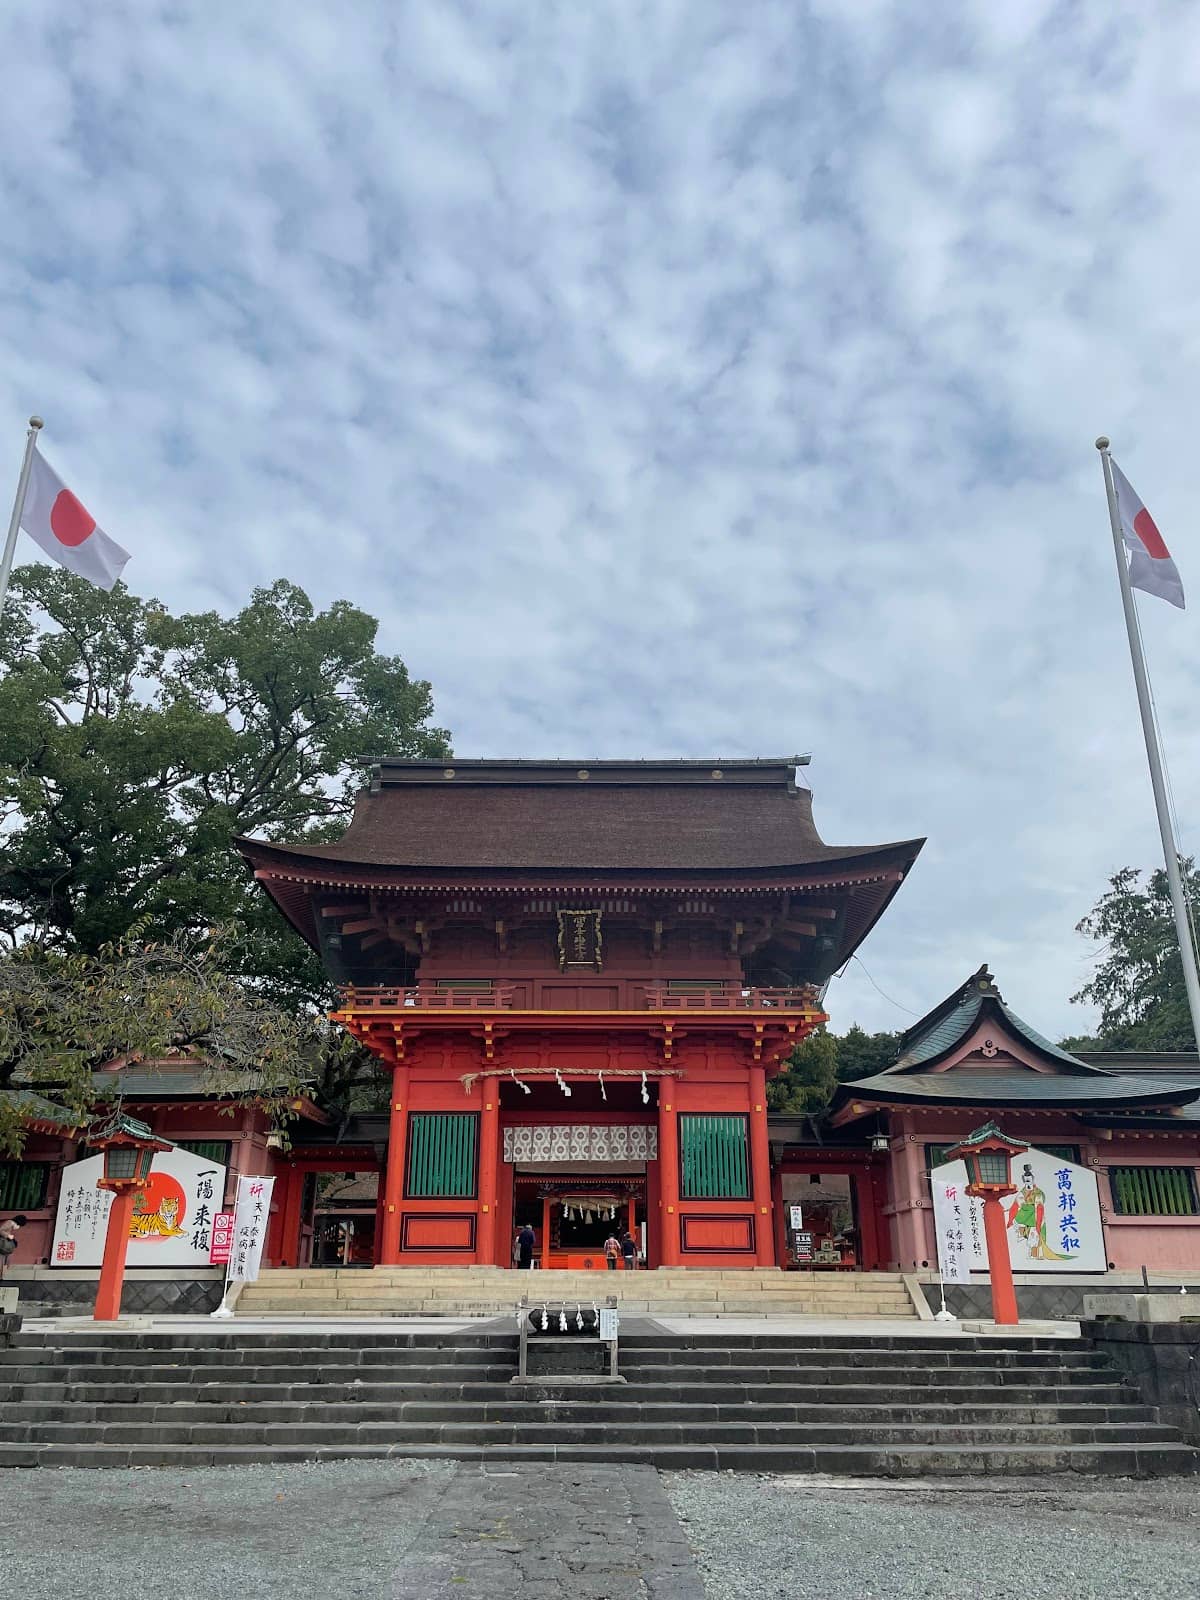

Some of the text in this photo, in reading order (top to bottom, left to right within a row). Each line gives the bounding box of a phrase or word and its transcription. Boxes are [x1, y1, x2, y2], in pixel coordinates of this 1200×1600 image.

[190, 1170, 218, 1252] 一陽来復
[249, 1183, 264, 1199] 祈
[944, 1186, 958, 1201] 祈
[1054, 1168, 1080, 1252] 萬邦共和
[946, 1228, 959, 1278] 疫病退散
[953, 1204, 965, 1253] 天下泰平
